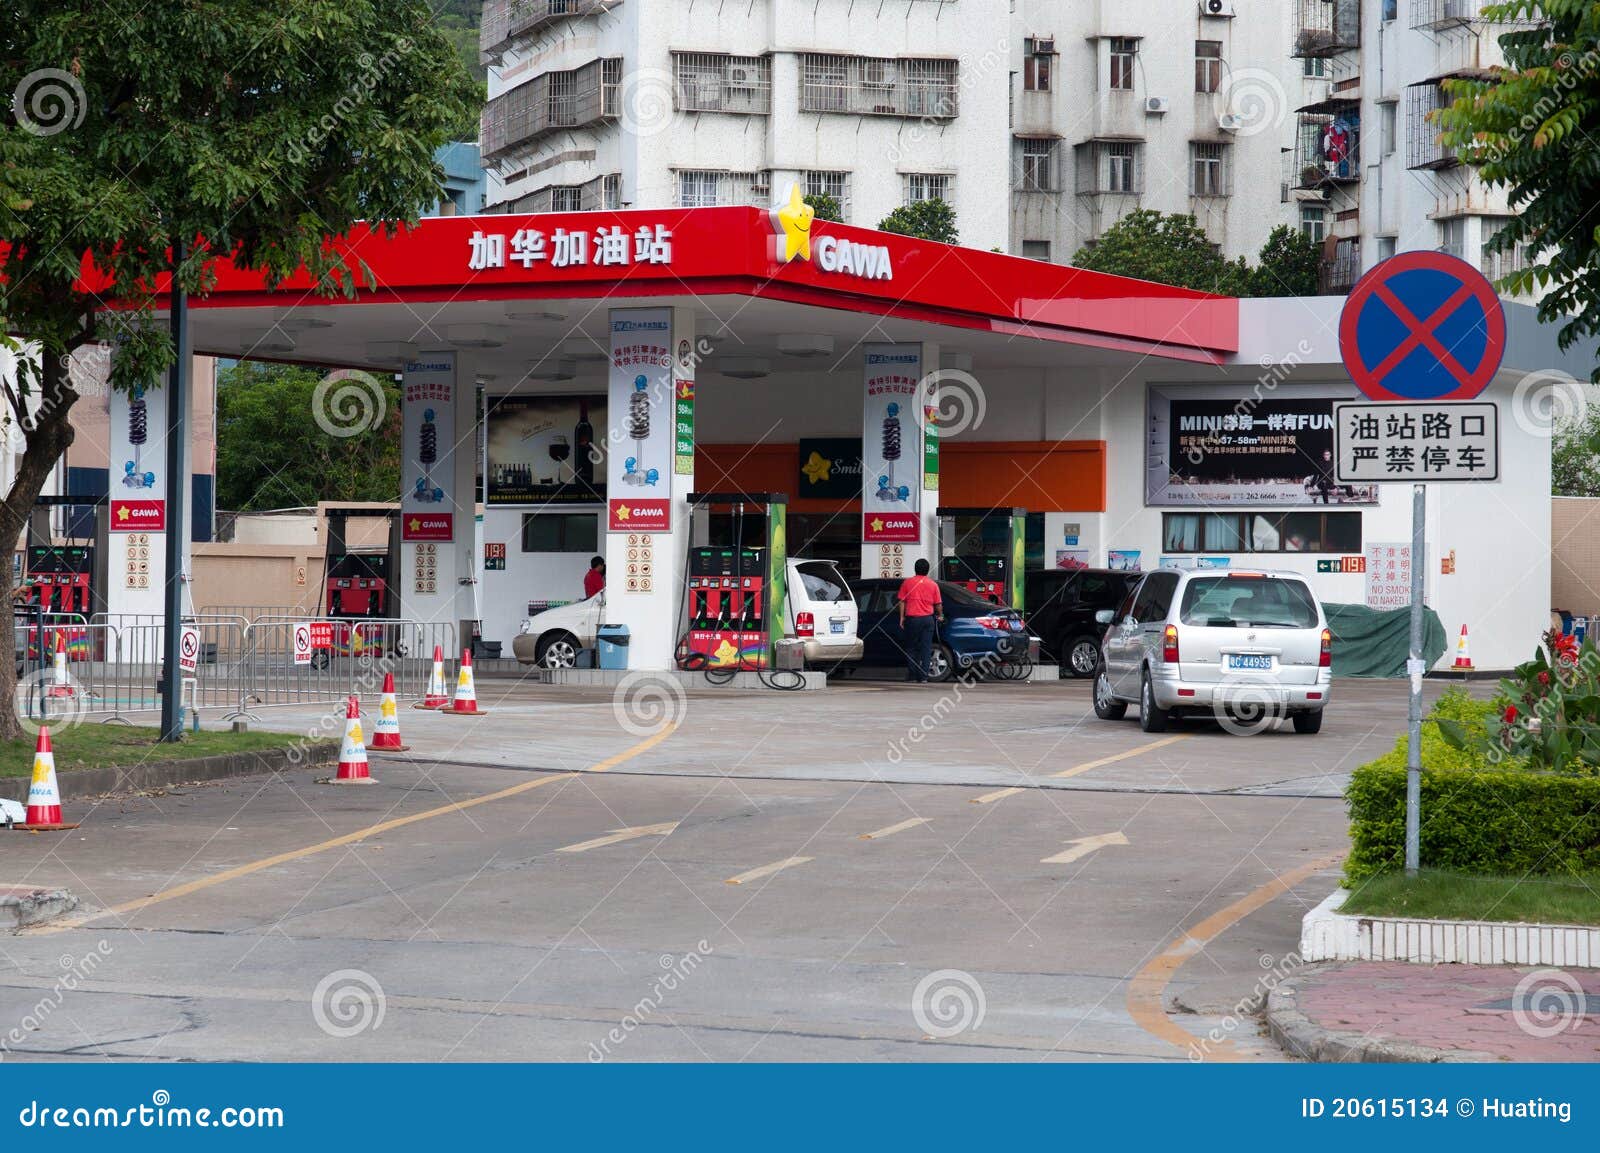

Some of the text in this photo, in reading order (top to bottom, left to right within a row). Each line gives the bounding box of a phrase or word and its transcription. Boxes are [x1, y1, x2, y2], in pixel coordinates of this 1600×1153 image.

[468, 224, 672, 269] 加华加油站
[814, 236, 893, 280] GAWA
[1350, 412, 1485, 440] 油站路口
[1351, 445, 1486, 472] 严禁停车
[831, 457, 864, 475] Smil
[132, 509, 159, 517] GAWA
[633, 508, 664, 517] GAWA
[422, 521, 448, 529] GAWA
[885, 521, 914, 529] GAWA
[754, 552, 759, 561] 1
[1372, 547, 1411, 558] 不准吸
[998, 560, 1003, 568] 5
[1343, 557, 1359, 572] 119
[1372, 559, 1411, 570] 不准明
[1371, 586, 1411, 595] NO SMOK
[1243, 656, 1271, 668] 44935
